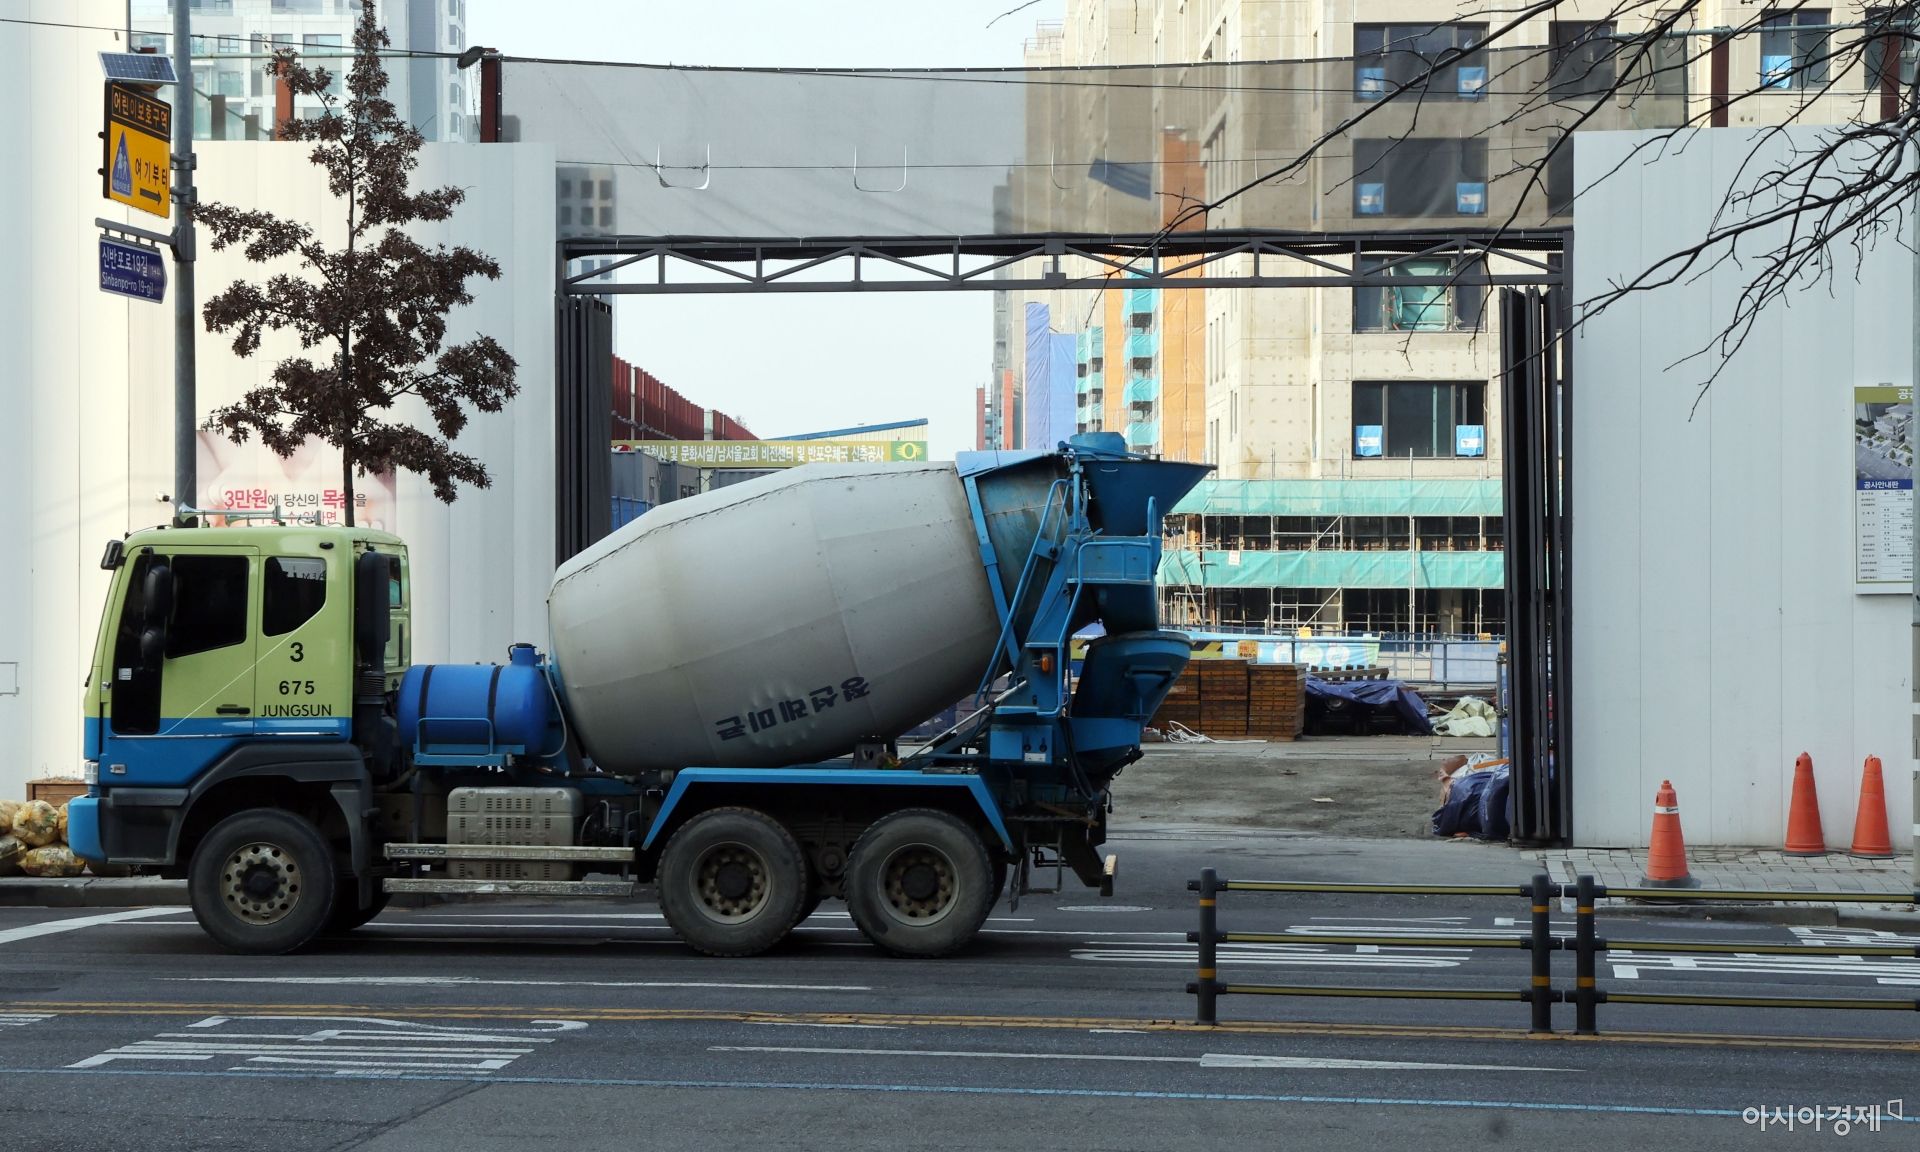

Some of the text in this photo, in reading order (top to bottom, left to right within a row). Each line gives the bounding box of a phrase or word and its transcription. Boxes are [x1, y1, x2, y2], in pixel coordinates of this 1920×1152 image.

[113, 91, 168, 131] 어린이보호구역
[135, 157, 168, 191] 여기부터
[102, 246, 148, 277] 신반포로19길
[102, 271, 154, 297] Sinbanpo-ro 19-gil
[634, 445, 884, 463] 공청사 및 문화시설/남서울교회 비전센터 및 반포우체국 신축공사
[1863, 481, 1899, 489] 공사안내판
[224, 489, 279, 509] 3만원에
[284, 493, 319, 508] 당신의
[290, 642, 304, 663] 3
[279, 680, 315, 695] 675
[260, 703, 332, 718] JUNGSUN
[715, 676, 871, 741] 정선레미콘
